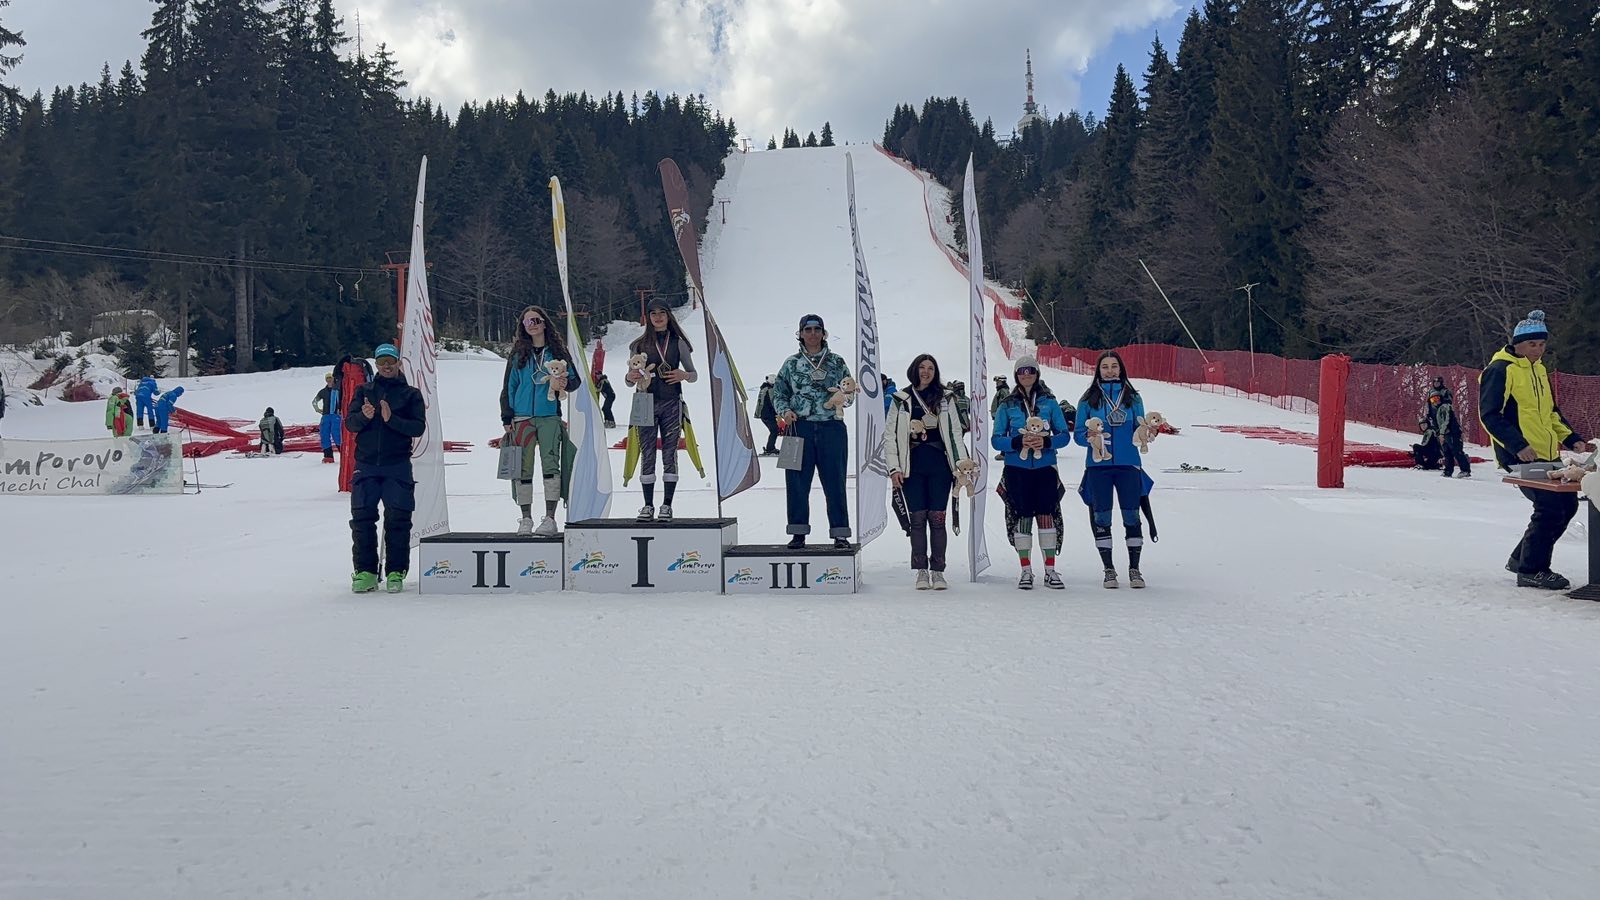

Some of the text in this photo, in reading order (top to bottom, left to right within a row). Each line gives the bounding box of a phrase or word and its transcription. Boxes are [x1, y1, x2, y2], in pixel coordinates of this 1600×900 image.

[0, 449, 122, 476] mPorovo
[57, 474, 100, 490] Chal
[894, 492, 906, 516] TEAM
[472, 550, 510, 588] II
[631, 536, 655, 588] I
[769, 562, 810, 589] III
